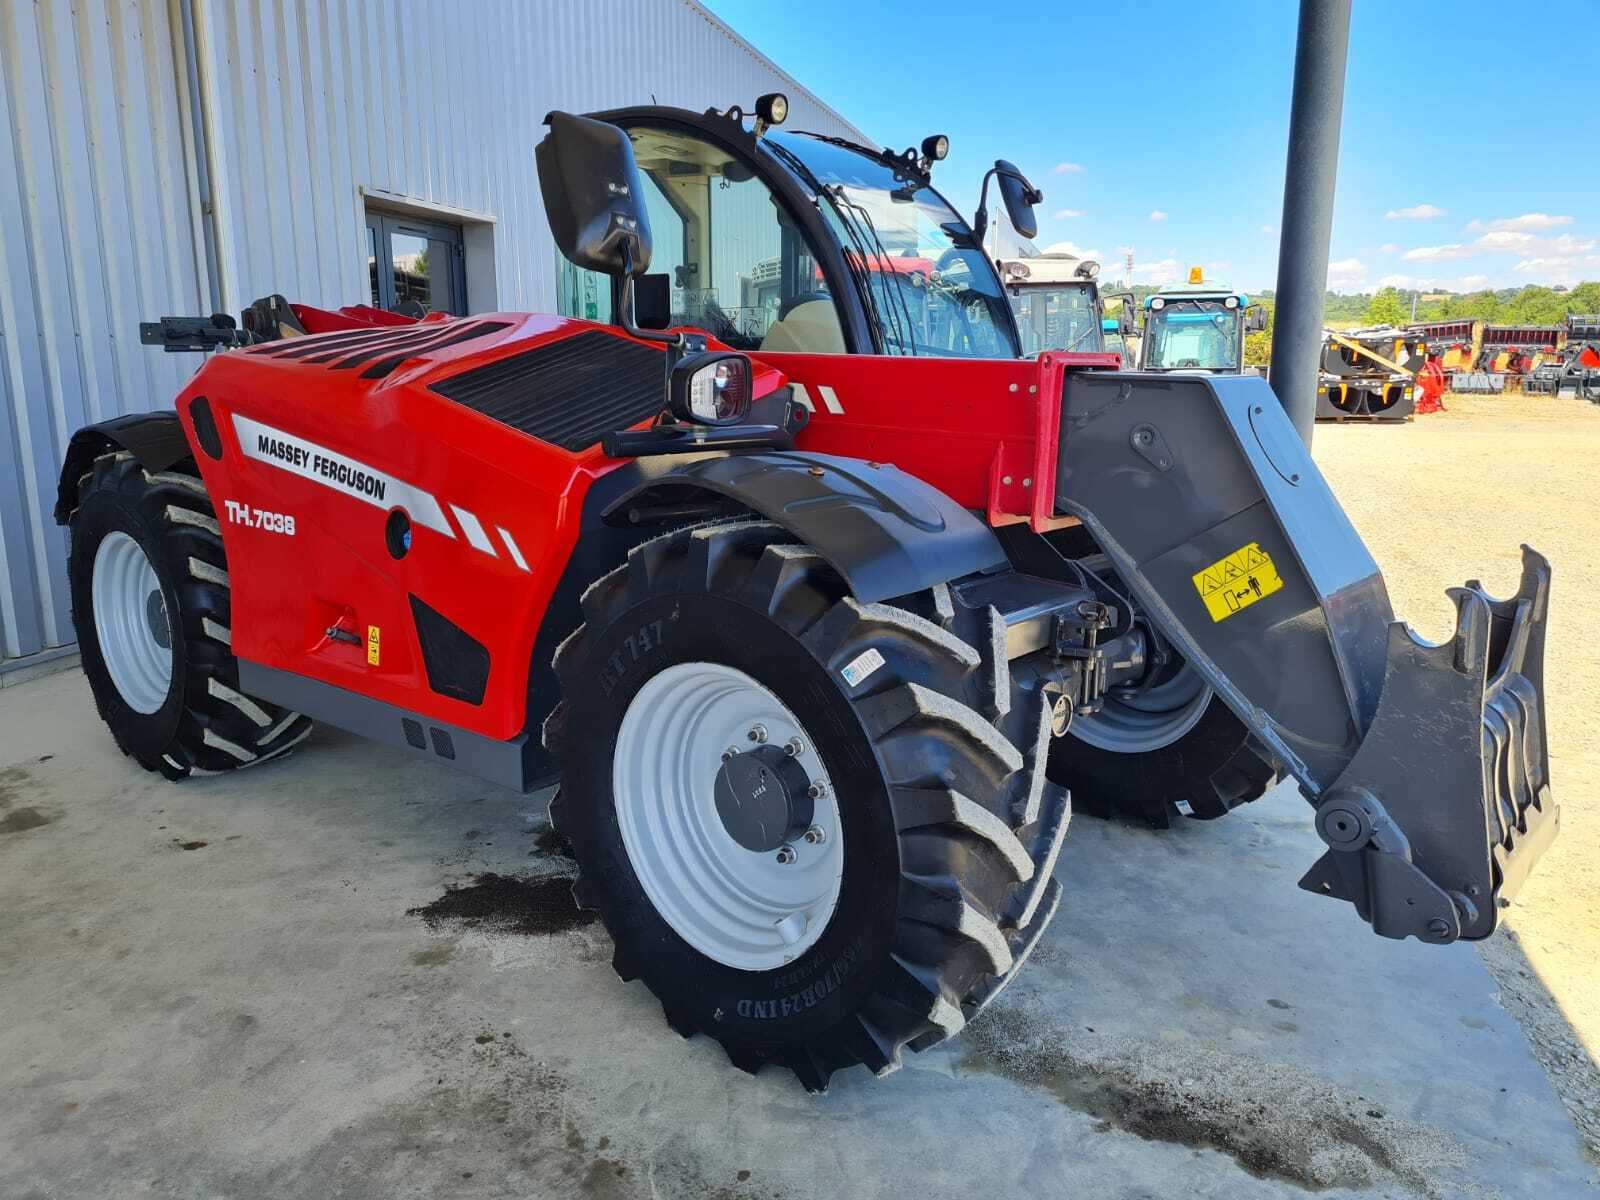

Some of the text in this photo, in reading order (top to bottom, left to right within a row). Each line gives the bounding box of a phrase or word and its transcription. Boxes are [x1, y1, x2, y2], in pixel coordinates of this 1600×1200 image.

[258, 434, 386, 501] MASSEY FERGUSON
[224, 499, 296, 536] TH.7038
[623, 619, 663, 661] 747
